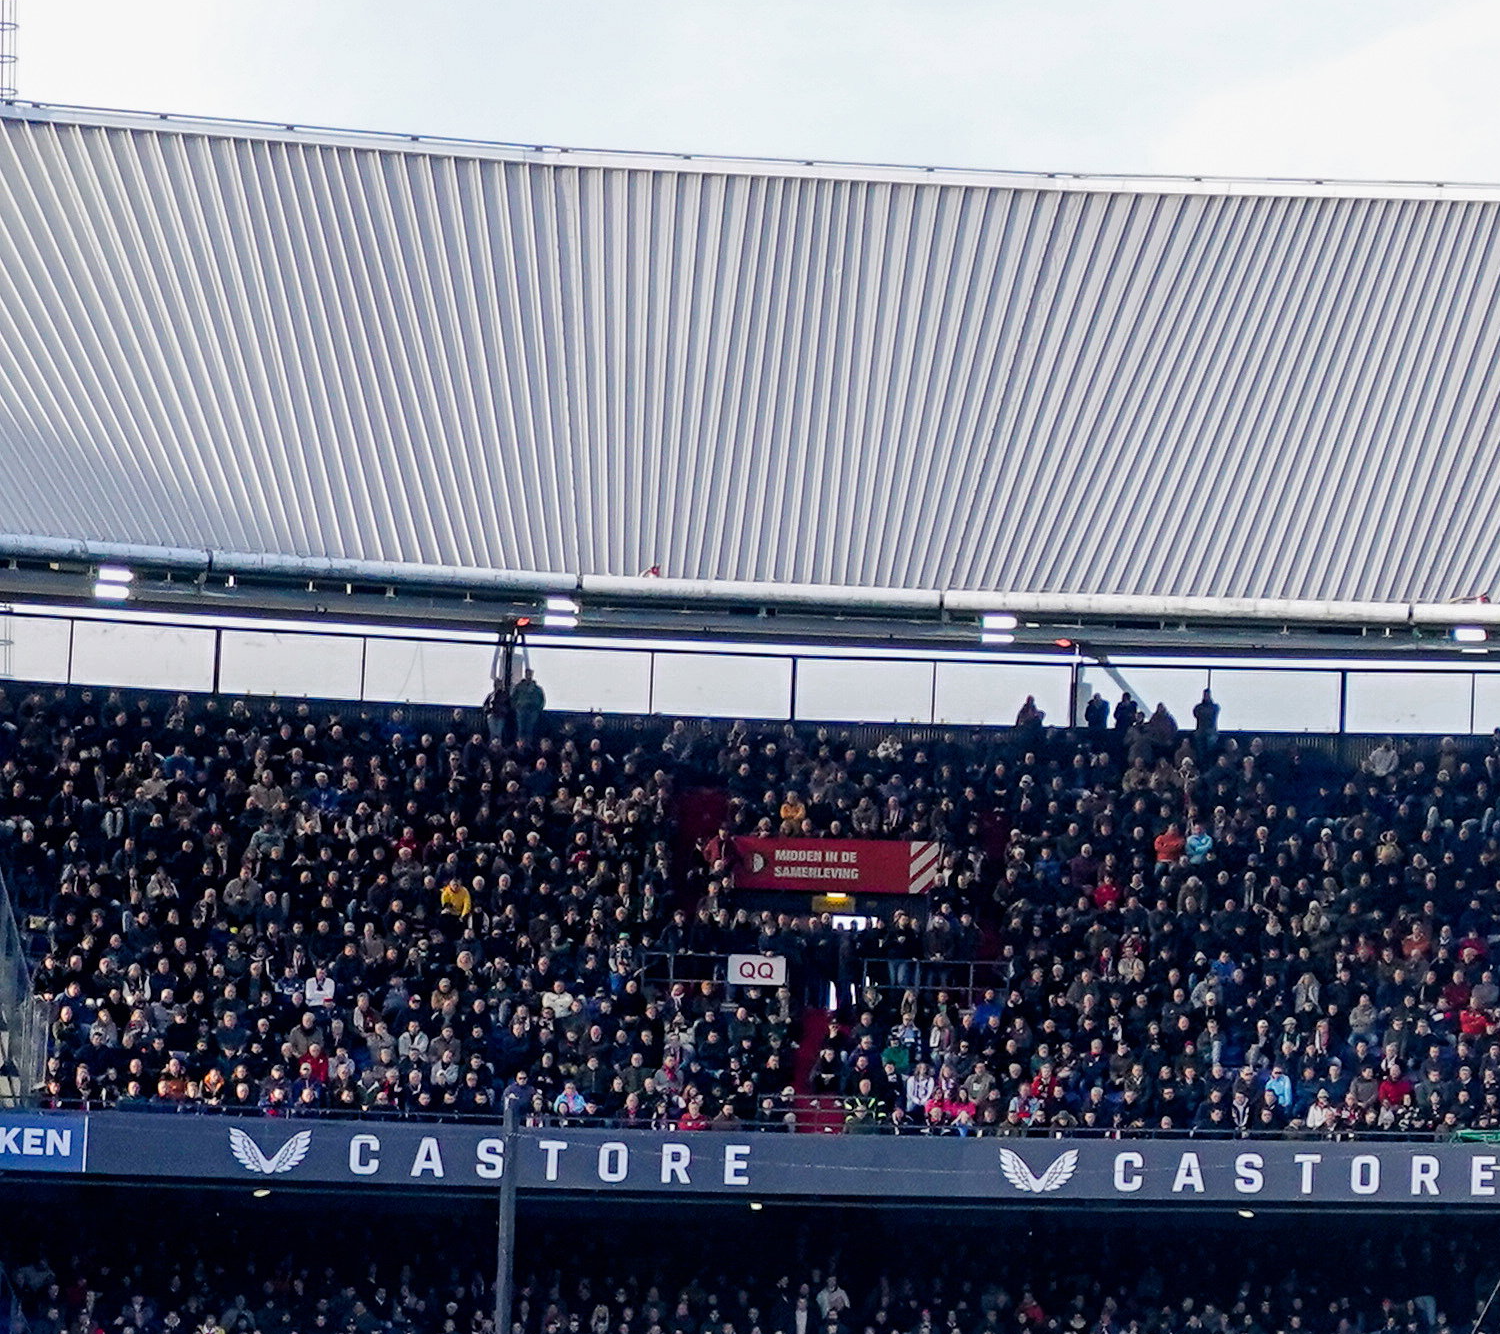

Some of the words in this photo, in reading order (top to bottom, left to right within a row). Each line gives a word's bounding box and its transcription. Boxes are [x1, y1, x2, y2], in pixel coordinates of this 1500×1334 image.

[775, 849, 824, 863] MIDDEN
[825, 850, 838, 863] IN
[841, 851, 857, 863] DE
[773, 866, 859, 880] SAMENLEVING
[739, 961, 774, 980] QQ
[349, 1134, 751, 1186] CASTORE
[1113, 1152, 1496, 1196] CASTORE
